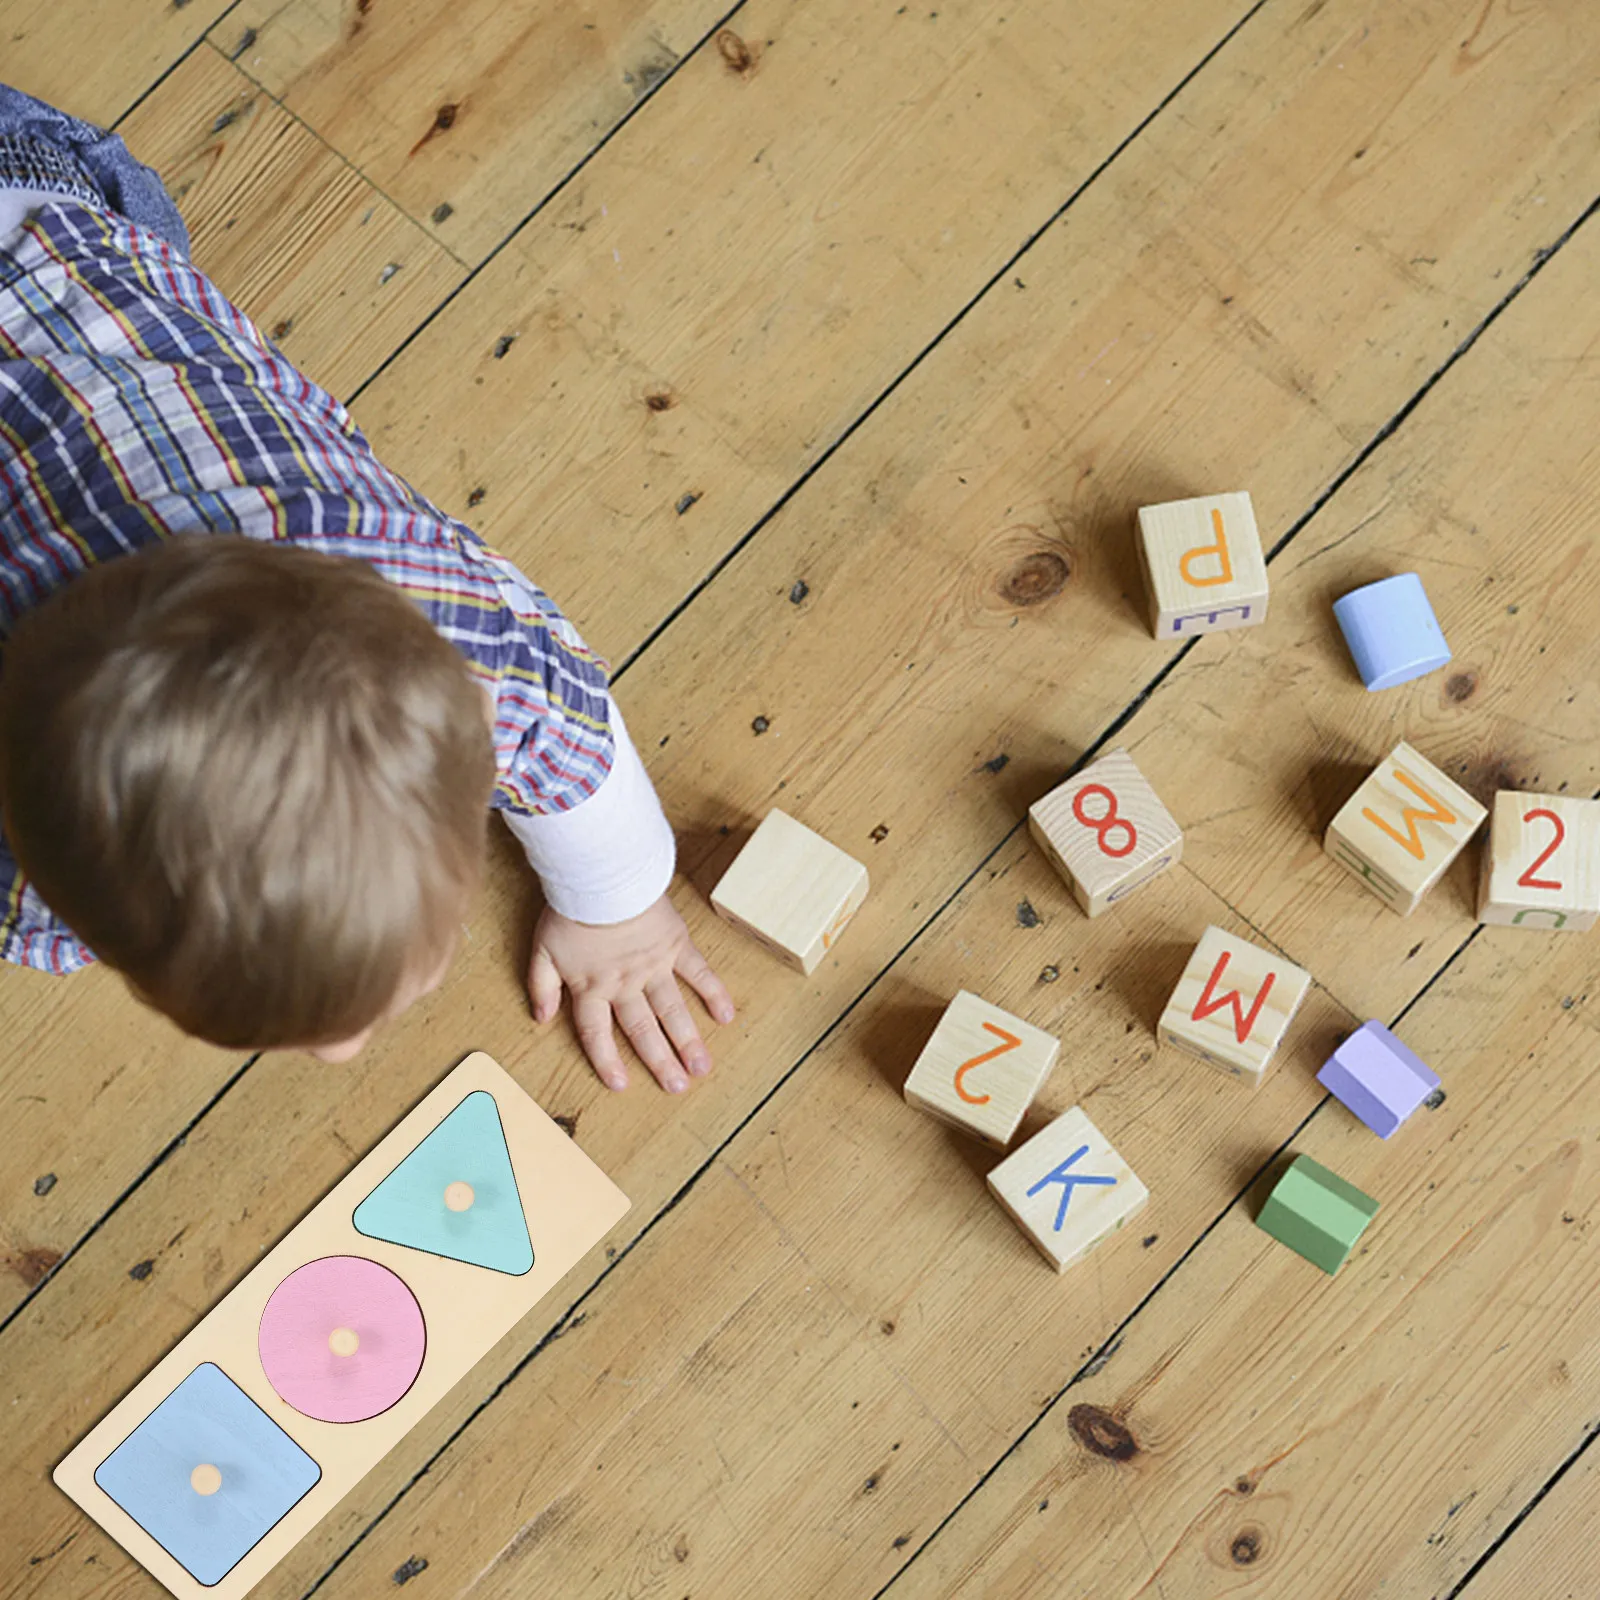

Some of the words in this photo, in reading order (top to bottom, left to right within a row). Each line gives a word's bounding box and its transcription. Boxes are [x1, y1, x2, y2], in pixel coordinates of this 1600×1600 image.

[1072, 783, 1137, 858] 8
[1517, 808, 1563, 890] 2
[954, 1021, 1022, 1105] 2
[1026, 1144, 1118, 1232] K
